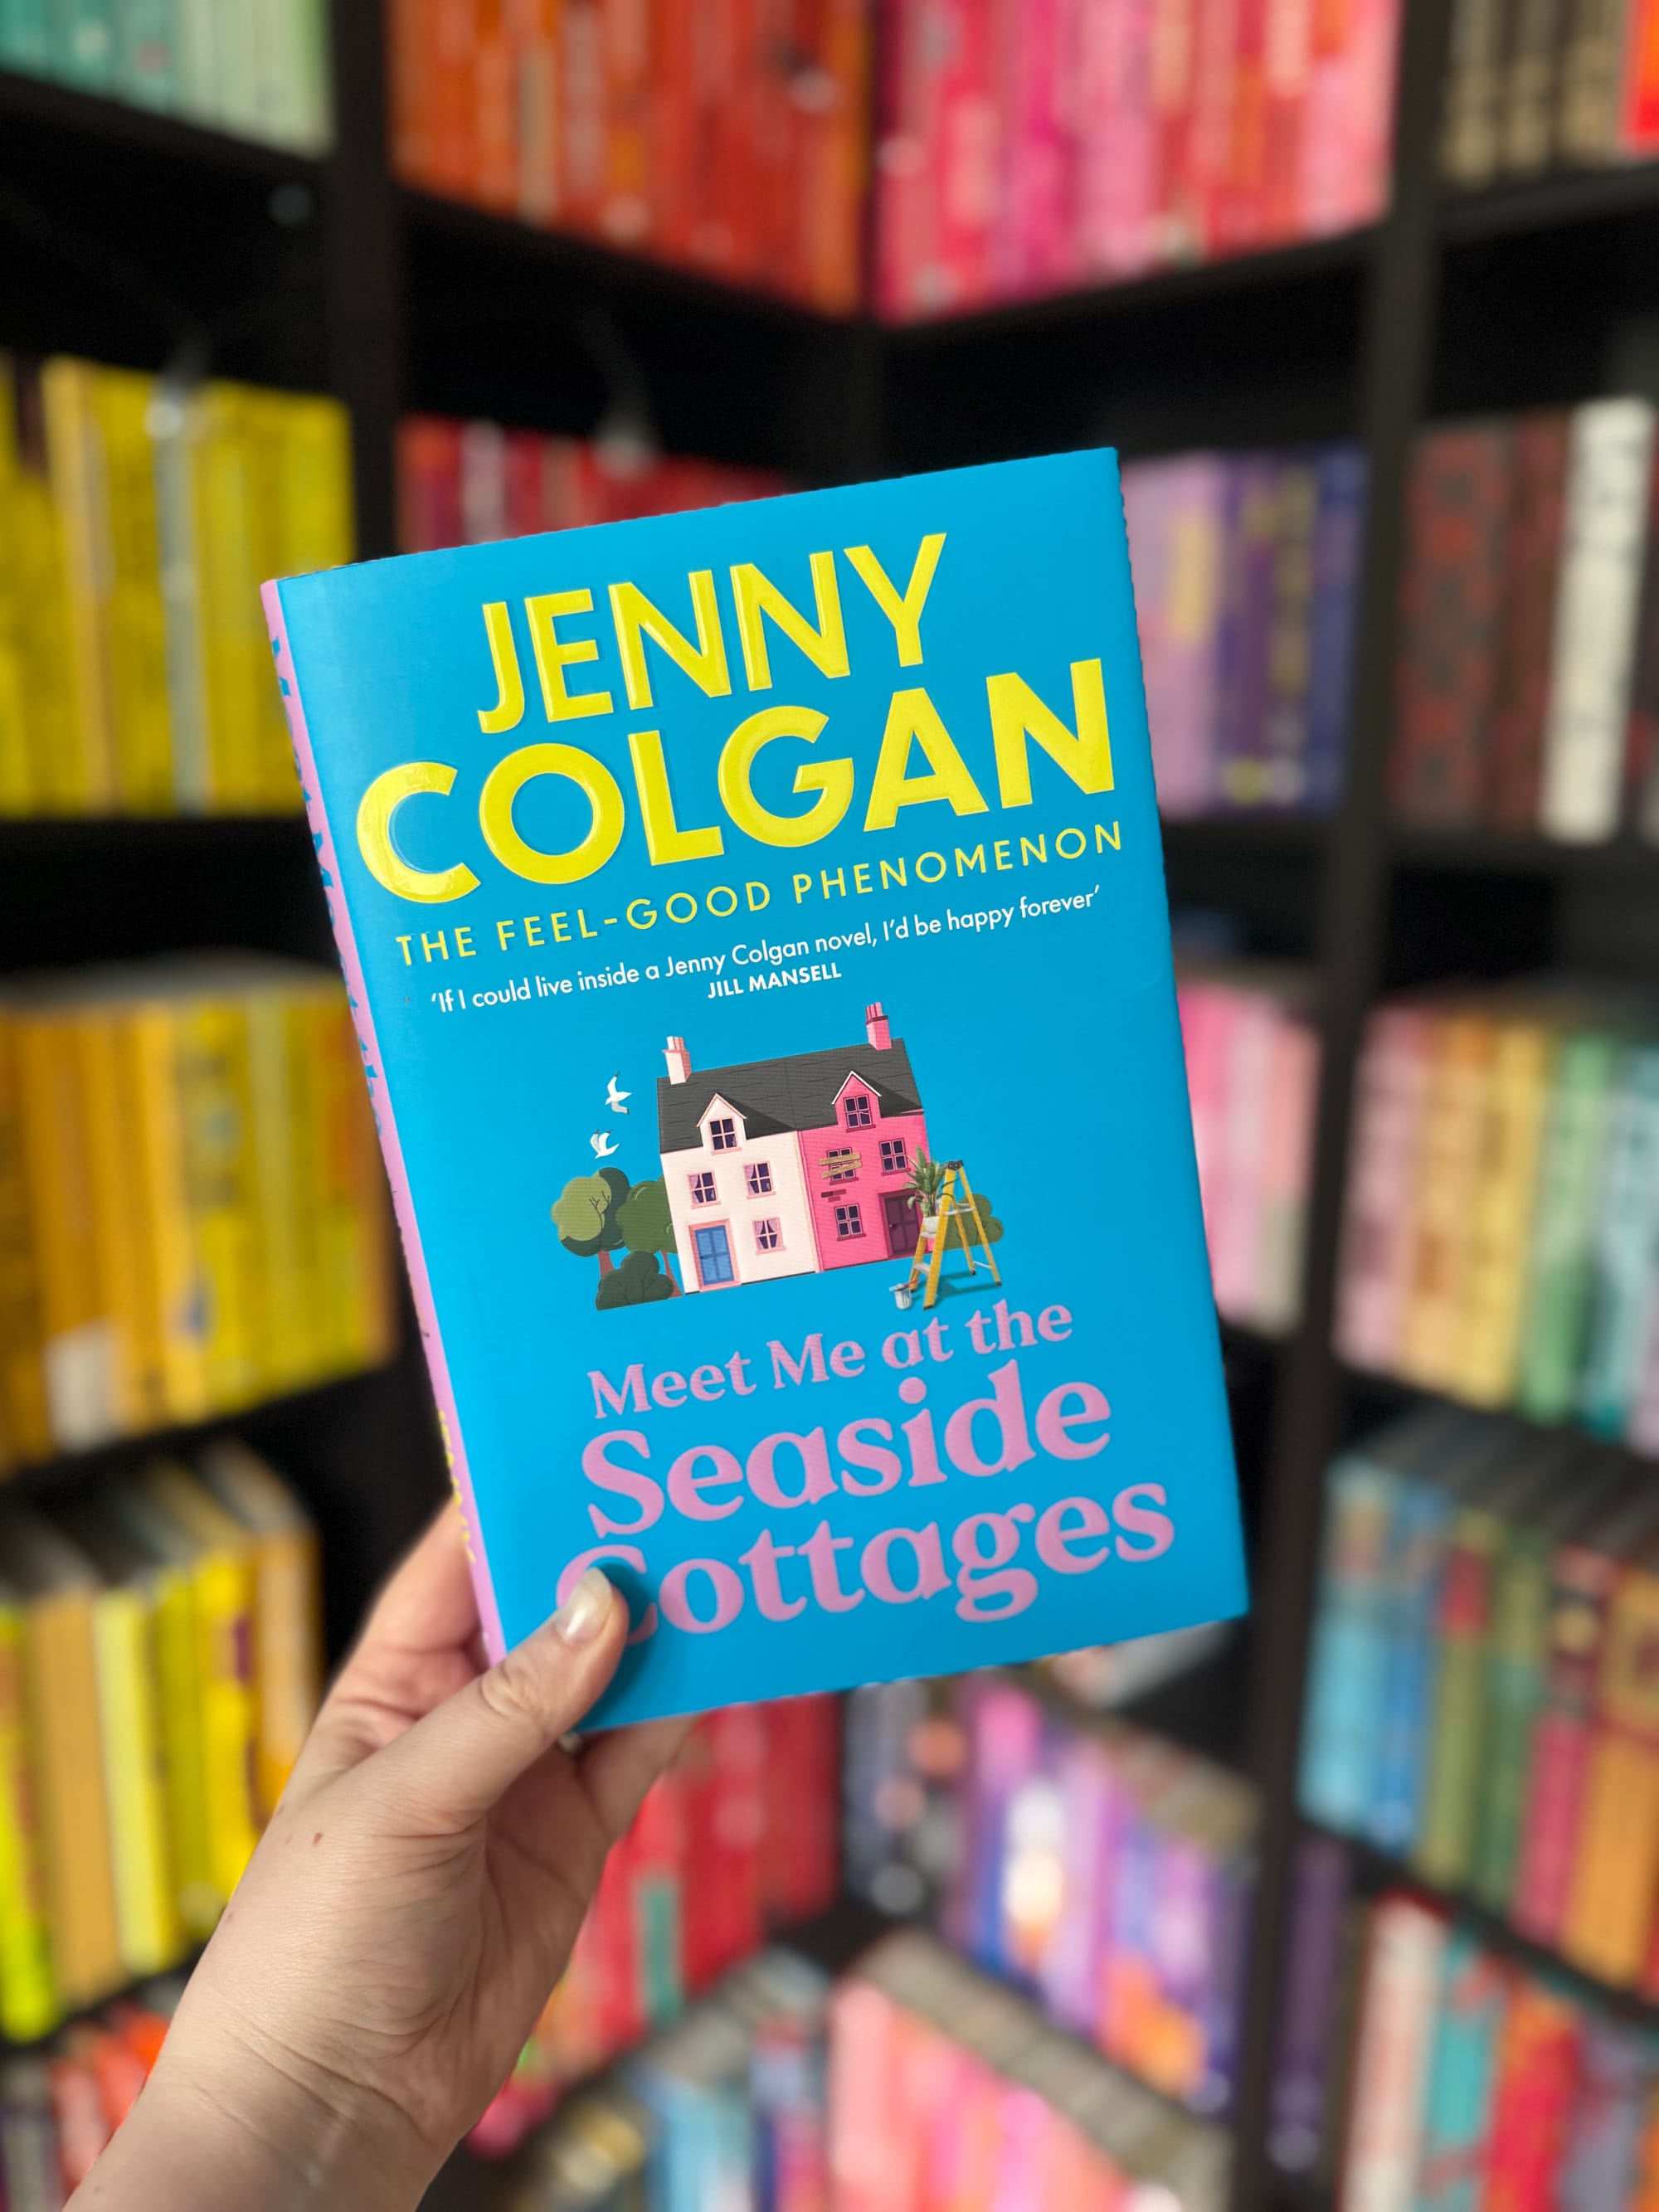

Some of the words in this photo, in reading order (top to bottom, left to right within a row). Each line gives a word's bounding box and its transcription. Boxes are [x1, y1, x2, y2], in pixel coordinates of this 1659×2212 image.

[478, 533, 946, 733] JENNY
[356, 659, 1114, 903] COLGAN
[396, 927, 476, 965] THE
[497, 882, 770, 950] FEEL-GOOD
[793, 822, 1121, 903] PHENOMENON
[458, 989, 466, 1009] I
[472, 977, 532, 1008] could
[535, 976, 573, 998] live
[578, 962, 640, 991] inside
[645, 965, 660, 980] a
[665, 955, 726, 977] Jenny
[732, 939, 810, 966] Colgan
[815, 922, 878, 953] novel,
[913, 914, 941, 936] be
[946, 907, 1014, 931] happy
[708, 978, 744, 999] JILL
[749, 962, 842, 992] MANSELL
[587, 1351, 757, 1419] Meet
[766, 1333, 865, 1389] Me
[882, 1317, 954, 1369] at
[965, 1299, 1073, 1354] the
[581, 1359, 1111, 1539] Seaside
